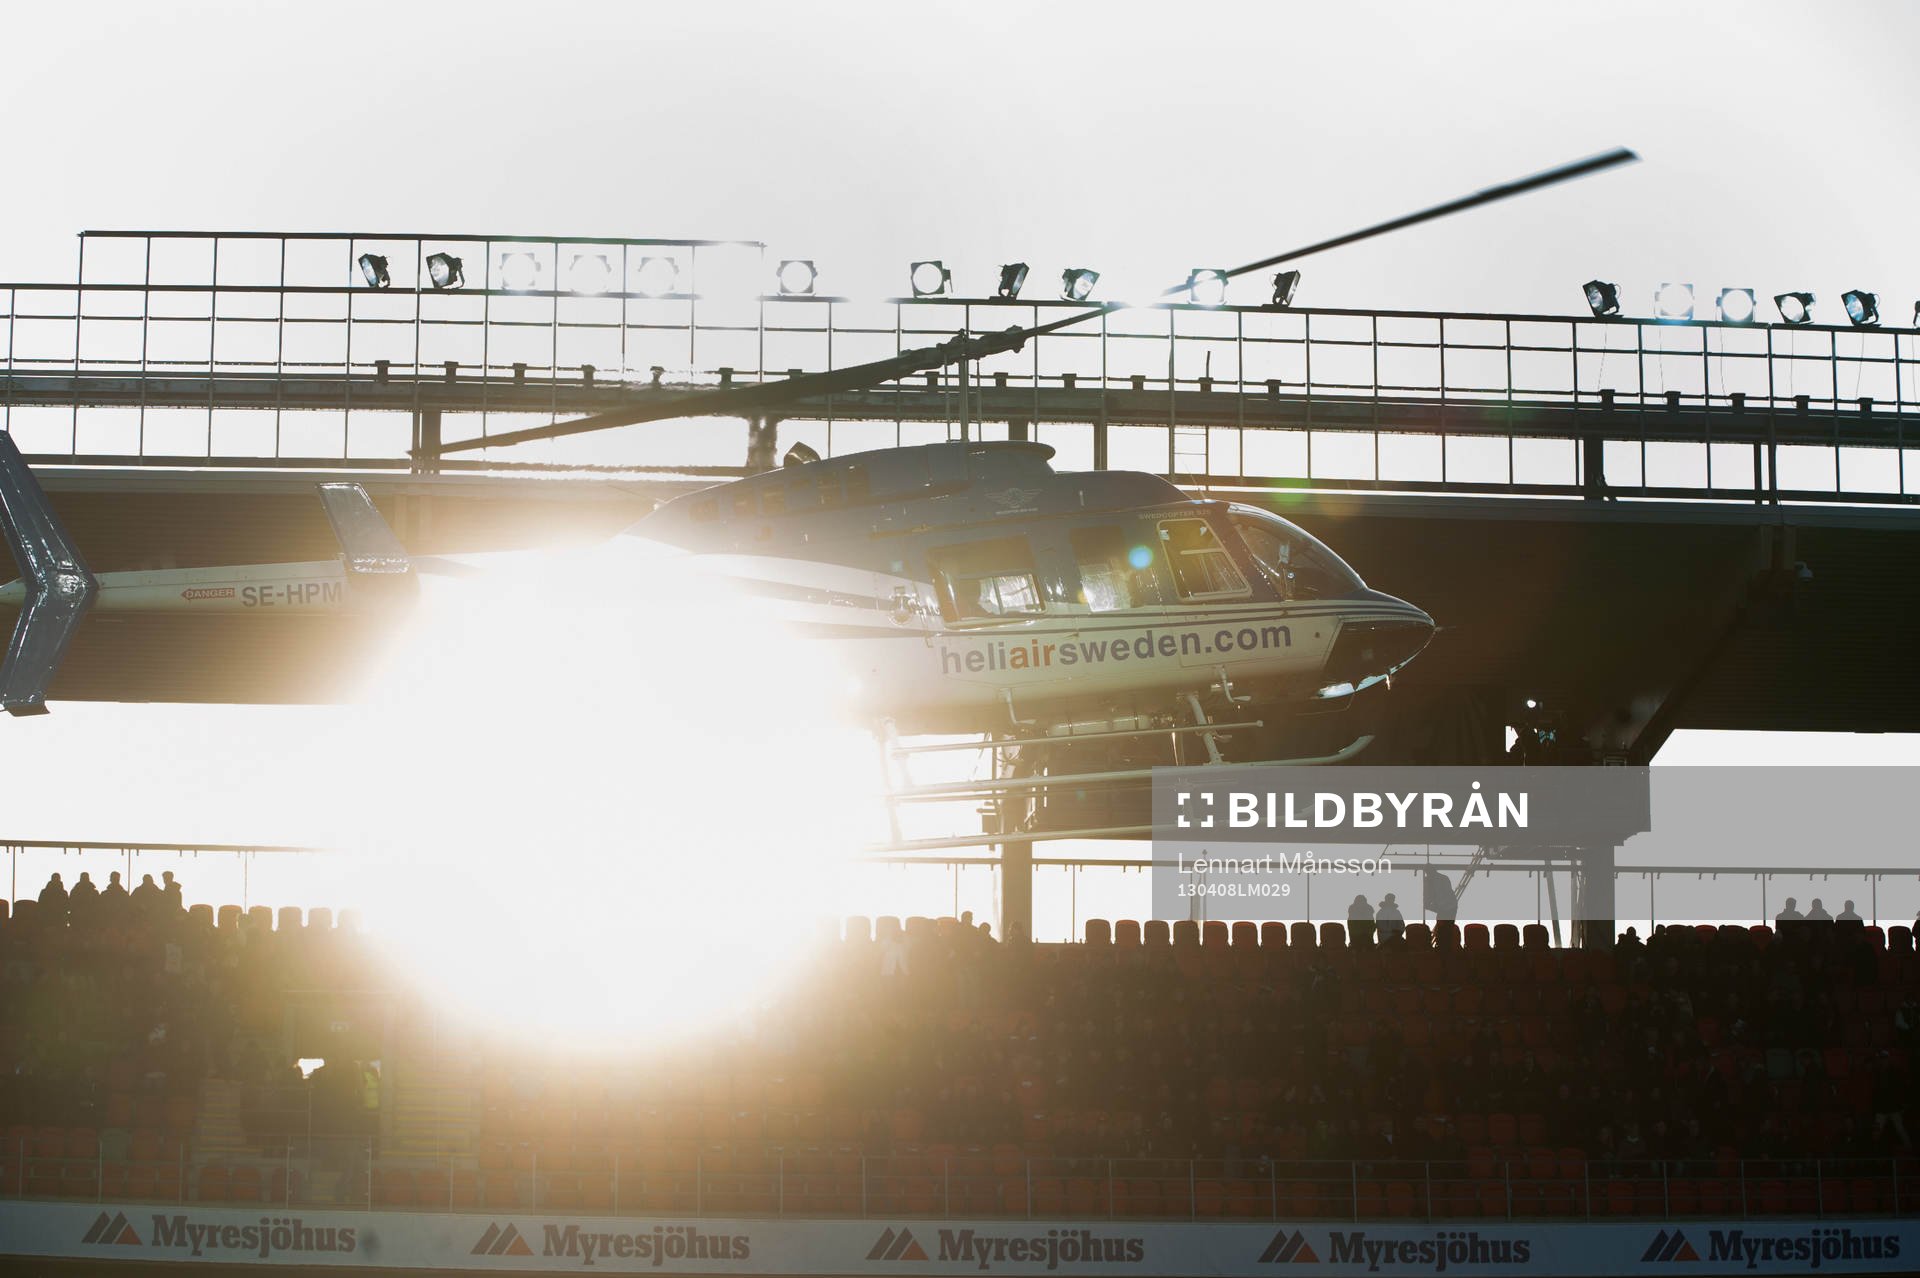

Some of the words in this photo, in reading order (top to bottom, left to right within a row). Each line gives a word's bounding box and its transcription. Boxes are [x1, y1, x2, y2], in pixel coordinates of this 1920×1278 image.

[184, 588, 235, 599] DANGER
[242, 583, 342, 607] SE-HPM
[940, 624, 1292, 673] heliairsweden.com
[153, 1214, 356, 1257] Myresjöhus
[543, 1223, 750, 1265] Myresjöhus
[939, 1229, 1144, 1269] Myresjöhus
[1329, 1231, 1531, 1272] Myresjöhus
[1709, 1229, 1899, 1269] Myresjöhus
